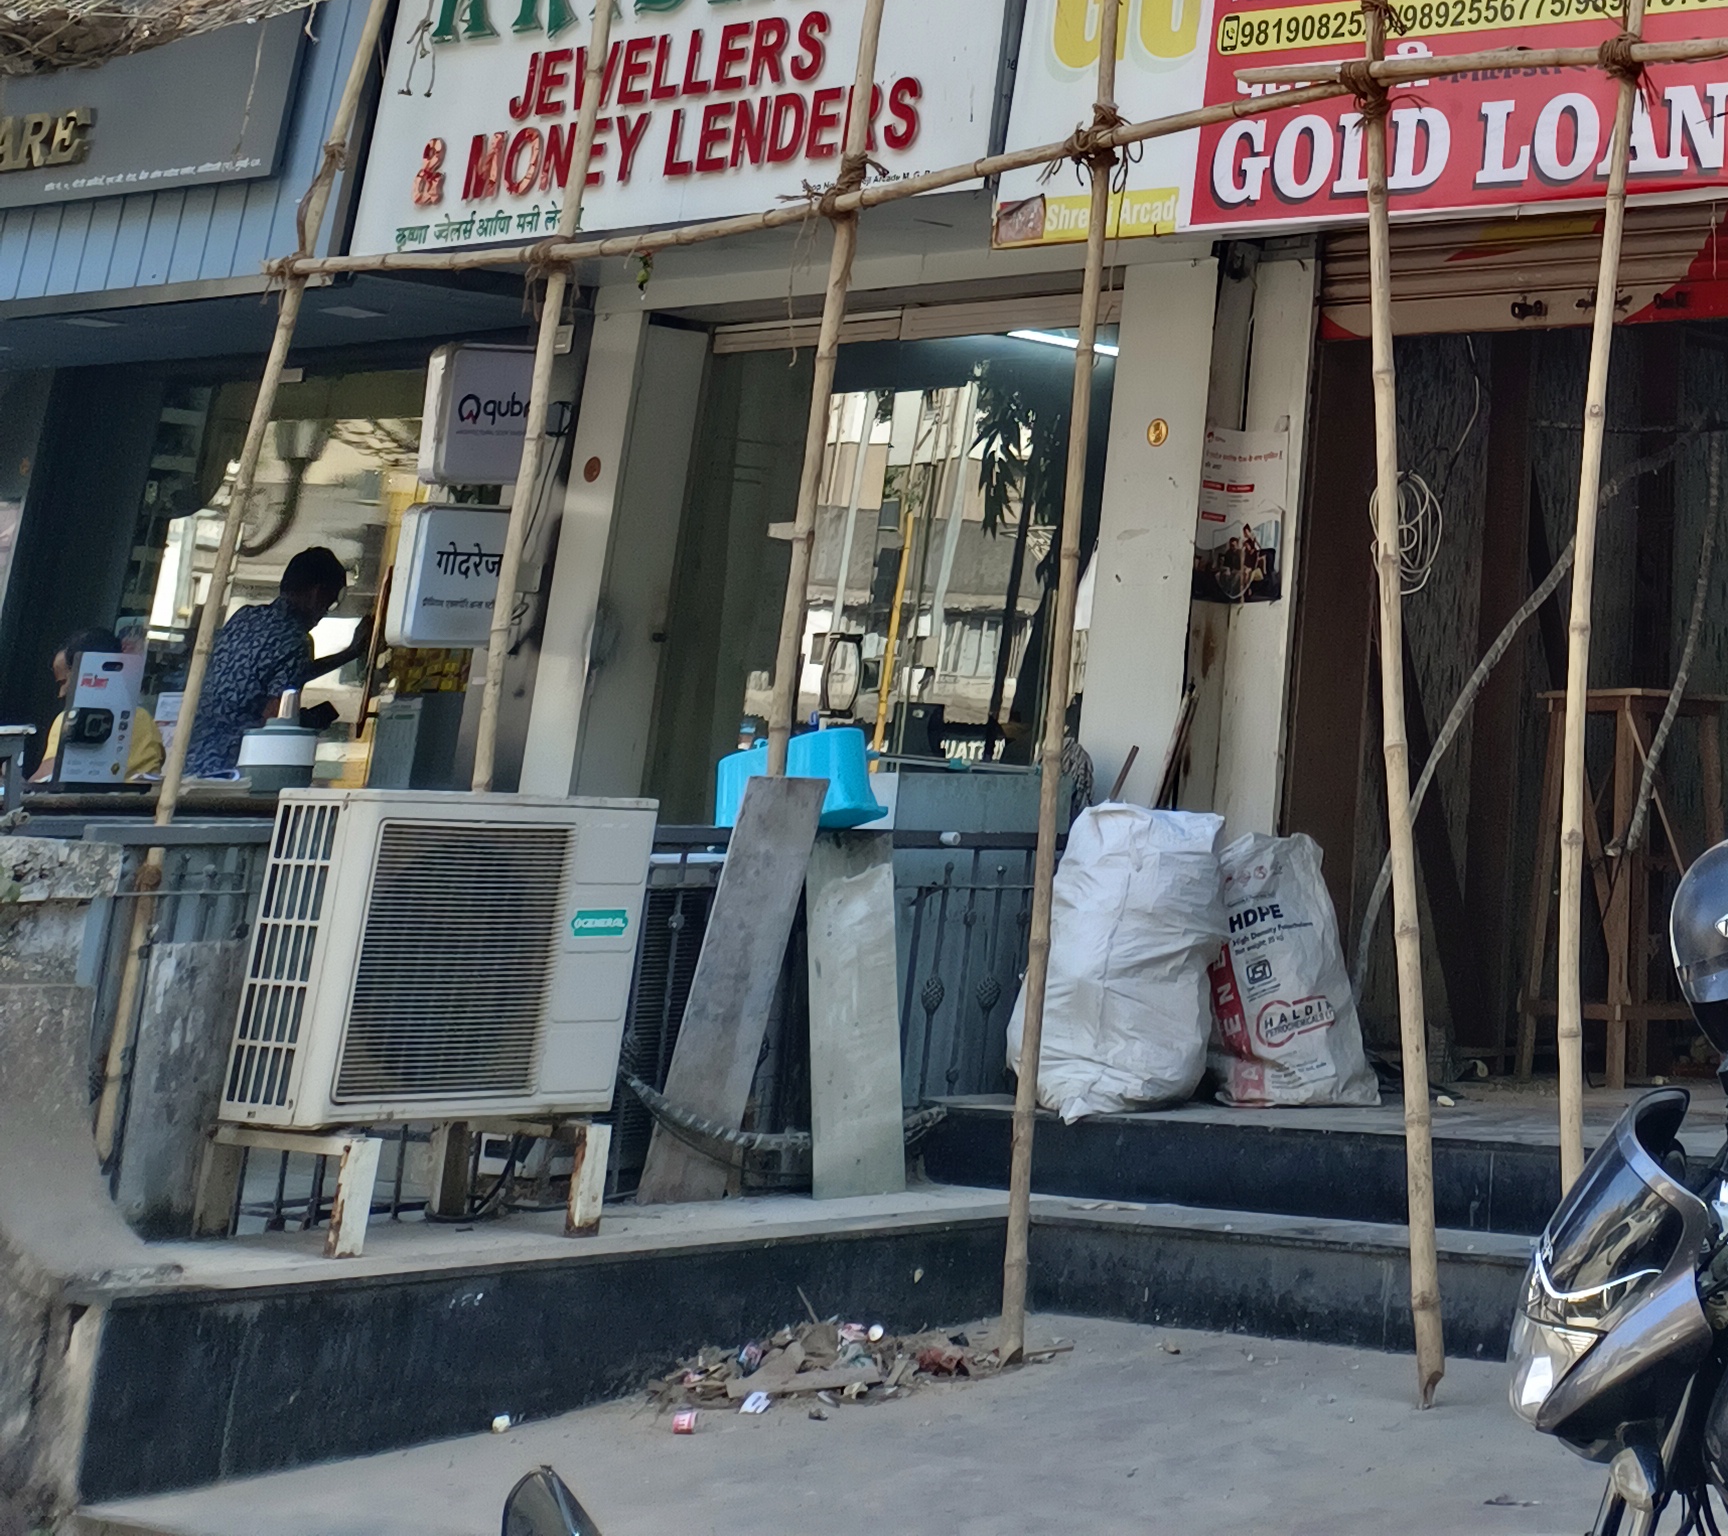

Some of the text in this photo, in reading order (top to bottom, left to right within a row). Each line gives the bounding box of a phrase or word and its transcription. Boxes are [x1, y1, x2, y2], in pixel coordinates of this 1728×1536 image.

[509, 11, 830, 121] JEWELLERS
[413, 138, 444, 206] &
[462, 110, 652, 200] MONEY
[1213, 107, 1451, 205] GOLD
[1047, 194, 1179, 231] Shrei Arcad
[436, 541, 504, 580] गोदरेज
[1229, 904, 1283, 933] HDPE
